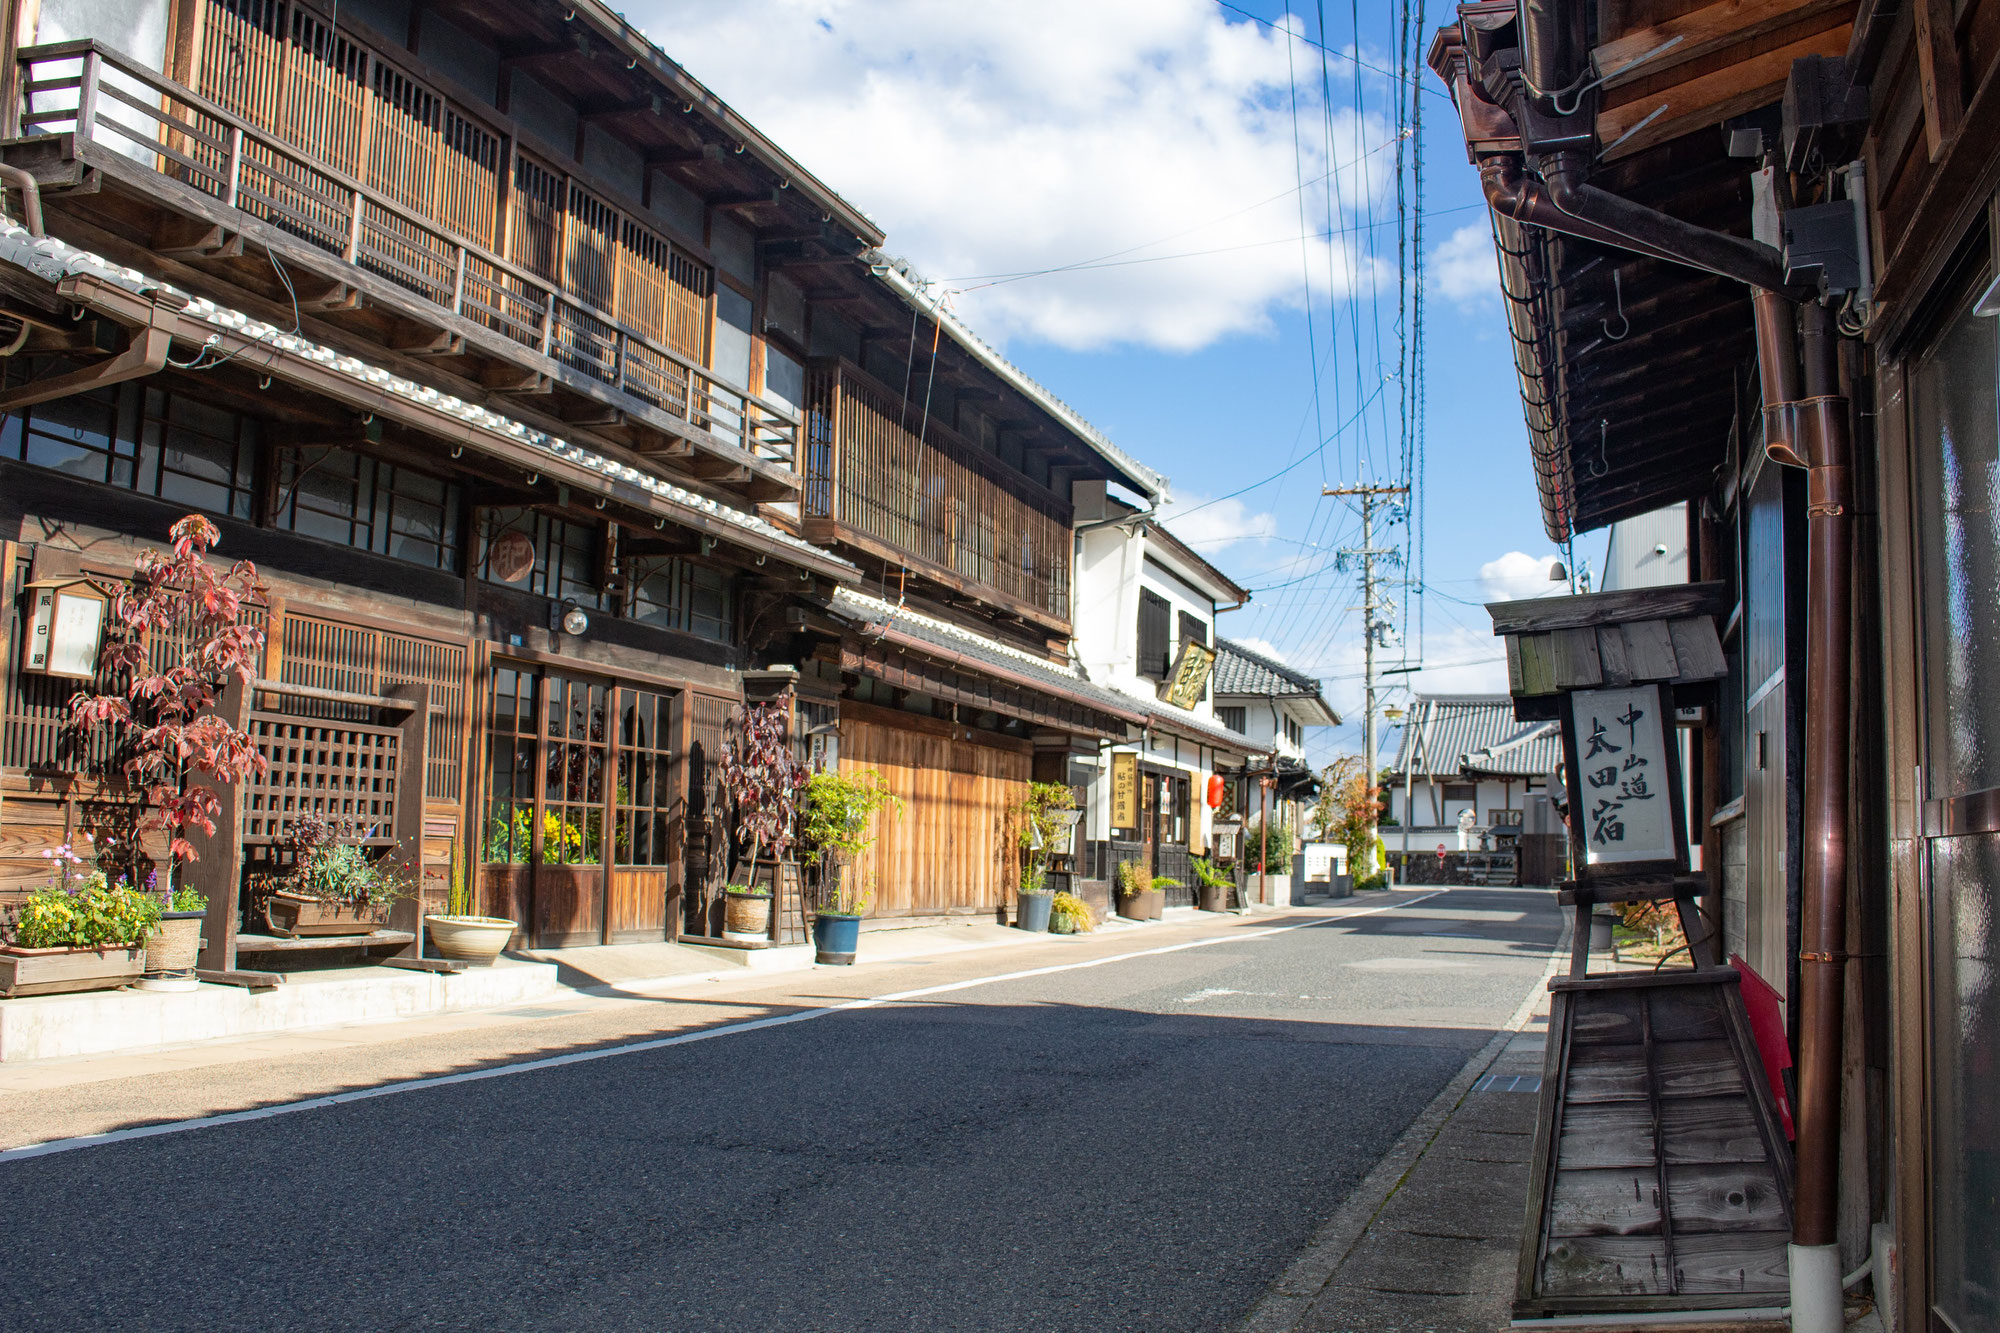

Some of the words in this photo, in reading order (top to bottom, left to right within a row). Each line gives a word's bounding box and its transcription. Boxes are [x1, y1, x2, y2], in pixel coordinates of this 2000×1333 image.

[33, 595, 51, 664] 辰巳屋
[1585, 716, 1624, 845] 太田宿
[1616, 703, 1655, 800] 中山道
